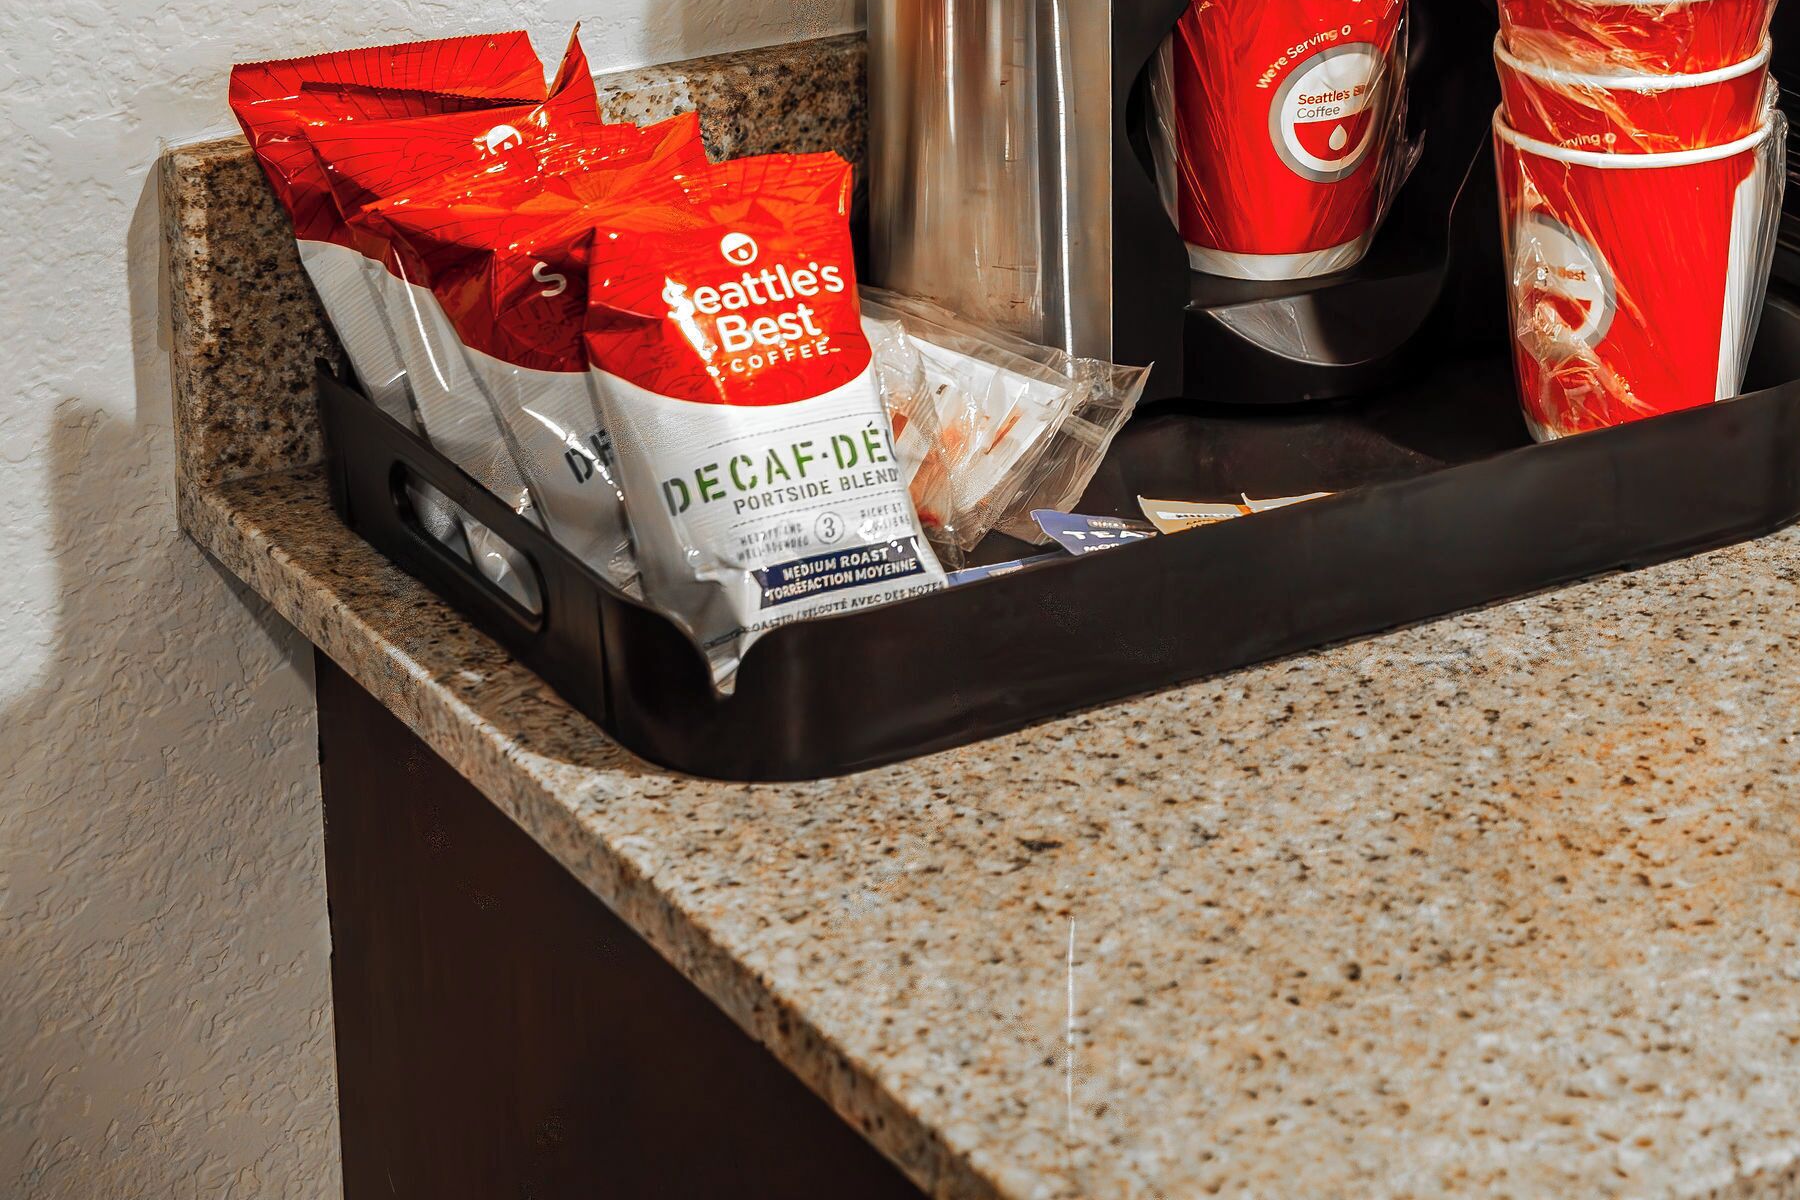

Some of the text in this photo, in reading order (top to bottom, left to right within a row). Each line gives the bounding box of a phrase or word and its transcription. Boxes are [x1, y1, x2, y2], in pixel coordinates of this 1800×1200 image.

[1286, 29, 1339, 59] Serving
[1296, 105, 1341, 119] Coffee
[1298, 89, 1351, 105] Seattle's
[662, 262, 845, 320] Seattle's
[716, 303, 822, 353] Best
[730, 340, 829, 373] COFFEE
[733, 466, 899, 515] PORTSIDE BLEND
[823, 517, 835, 539] 3
[782, 547, 890, 581] MEDIUM ROAST
[854, 557, 918, 582] MOYENNE
[850, 592, 883, 609] AVEC
